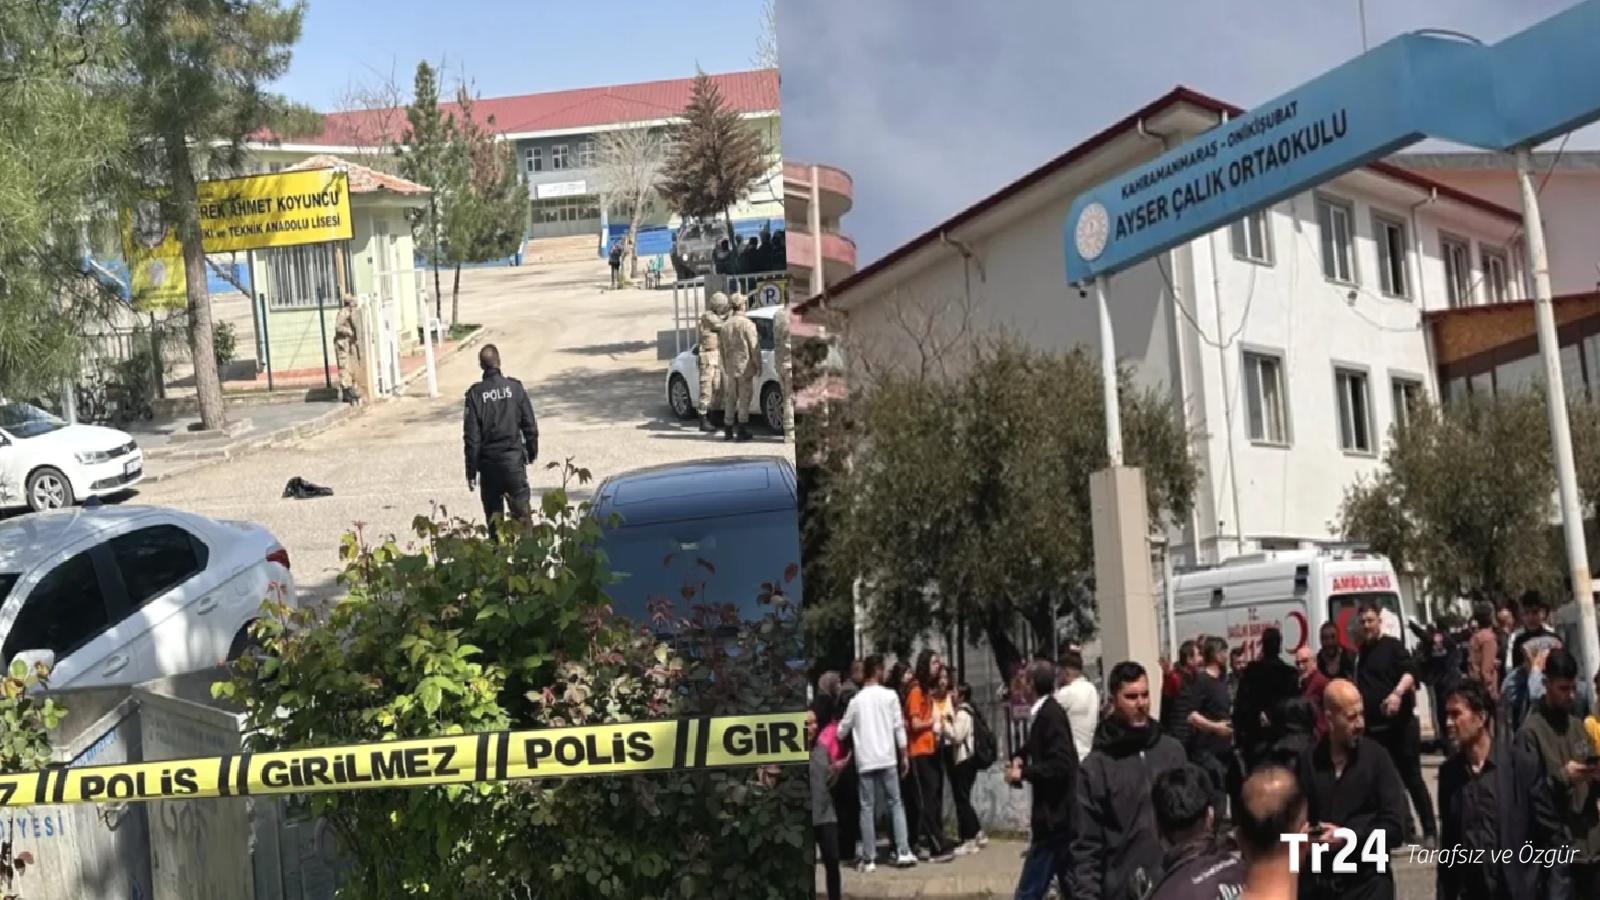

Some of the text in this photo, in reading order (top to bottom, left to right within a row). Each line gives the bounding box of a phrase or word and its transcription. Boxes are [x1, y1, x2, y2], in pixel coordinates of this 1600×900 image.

[1115, 109, 1347, 240] AYSER ÇALIK ORTAOKULU
[1121, 141, 1219, 200] KAHRAMANMARAŞ
[1227, 101, 1298, 147] ONİKİŞUBAT
[200, 191, 339, 219] REK AHMET KOYUNCU
[266, 219, 309, 233] ANADOLU
[311, 213, 341, 229] LİSESİ
[1333, 575, 1391, 591] AMBULANS
[80, 769, 198, 801] POLİS
[261, 744, 460, 787] GİRİLMEZ
[525, 731, 654, 769] POLİS
